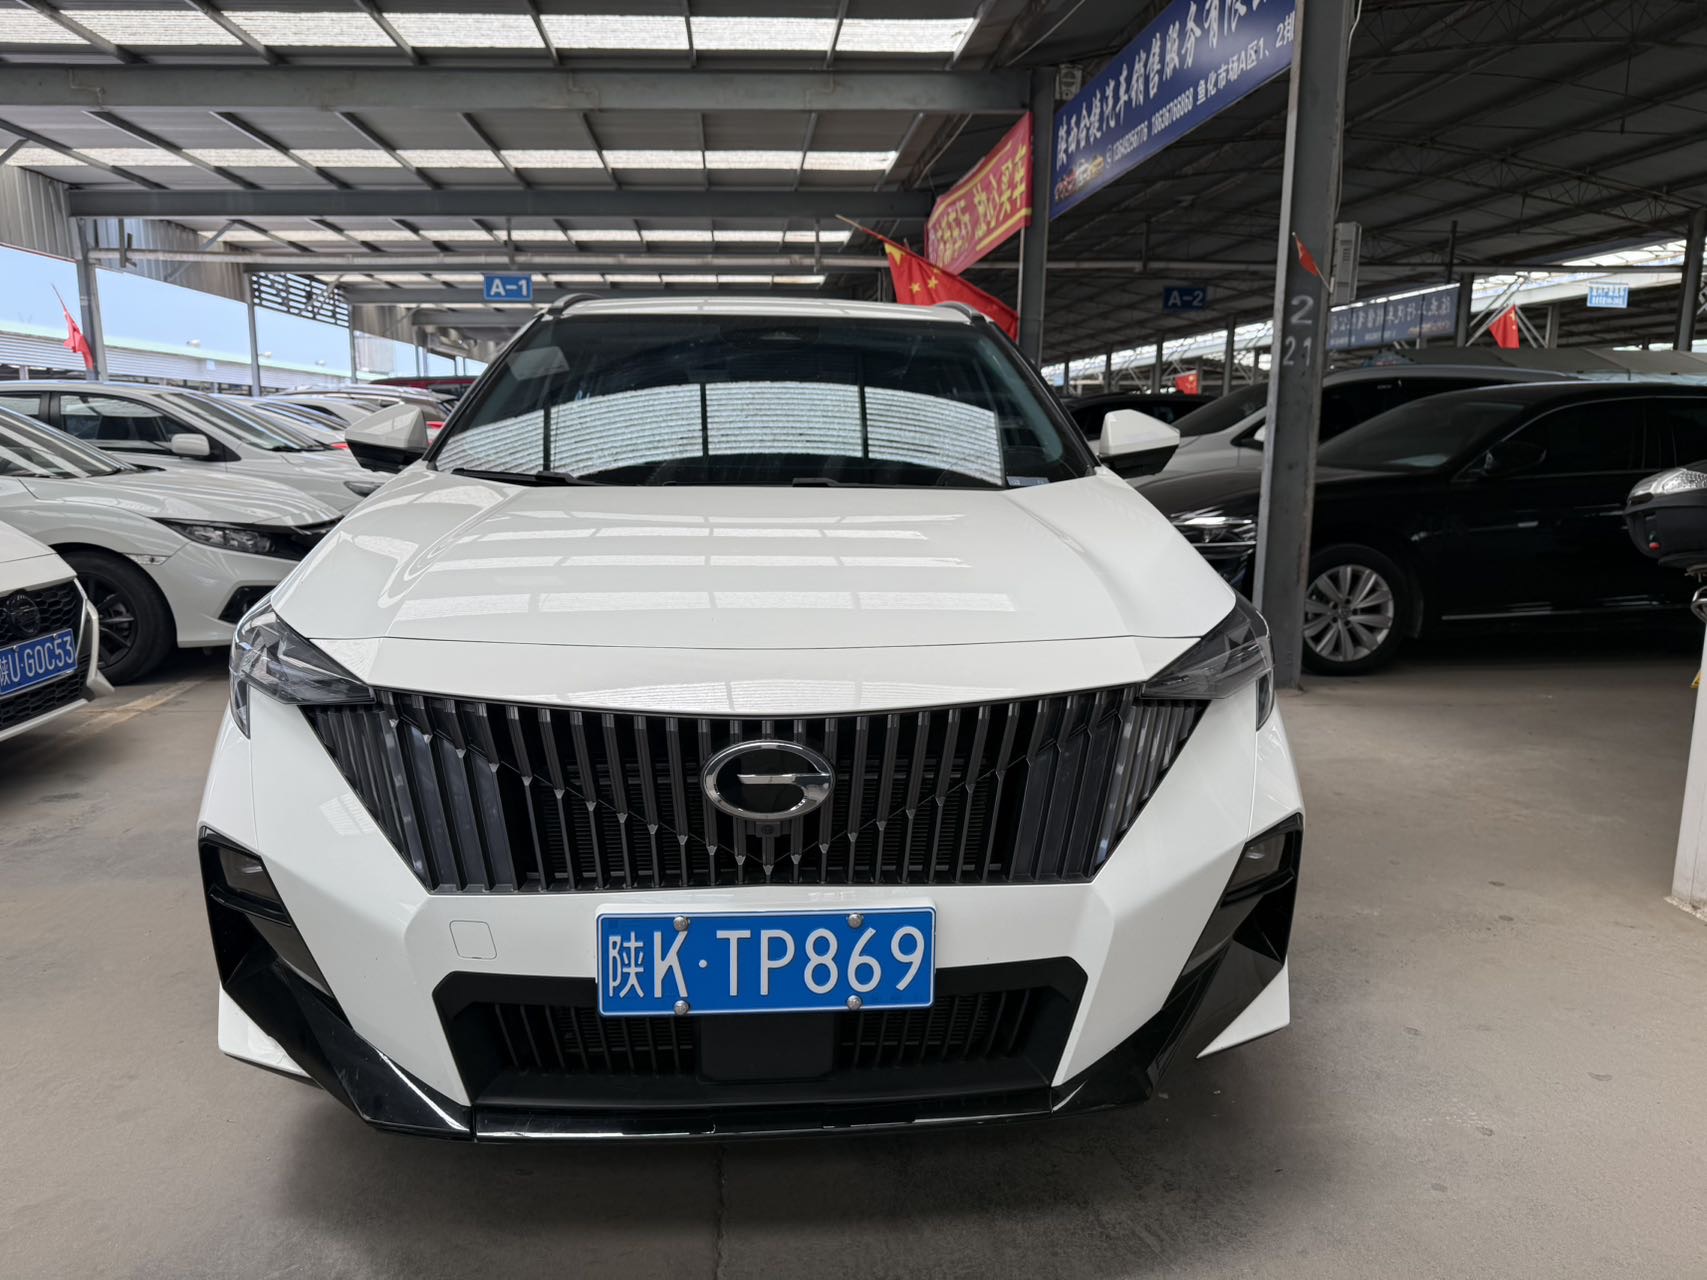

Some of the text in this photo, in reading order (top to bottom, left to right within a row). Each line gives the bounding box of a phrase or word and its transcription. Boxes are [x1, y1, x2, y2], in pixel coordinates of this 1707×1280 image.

[490, 278, 528, 296] A-1
[1168, 290, 1204, 307] A-2
[1290, 295, 1314, 325] 2
